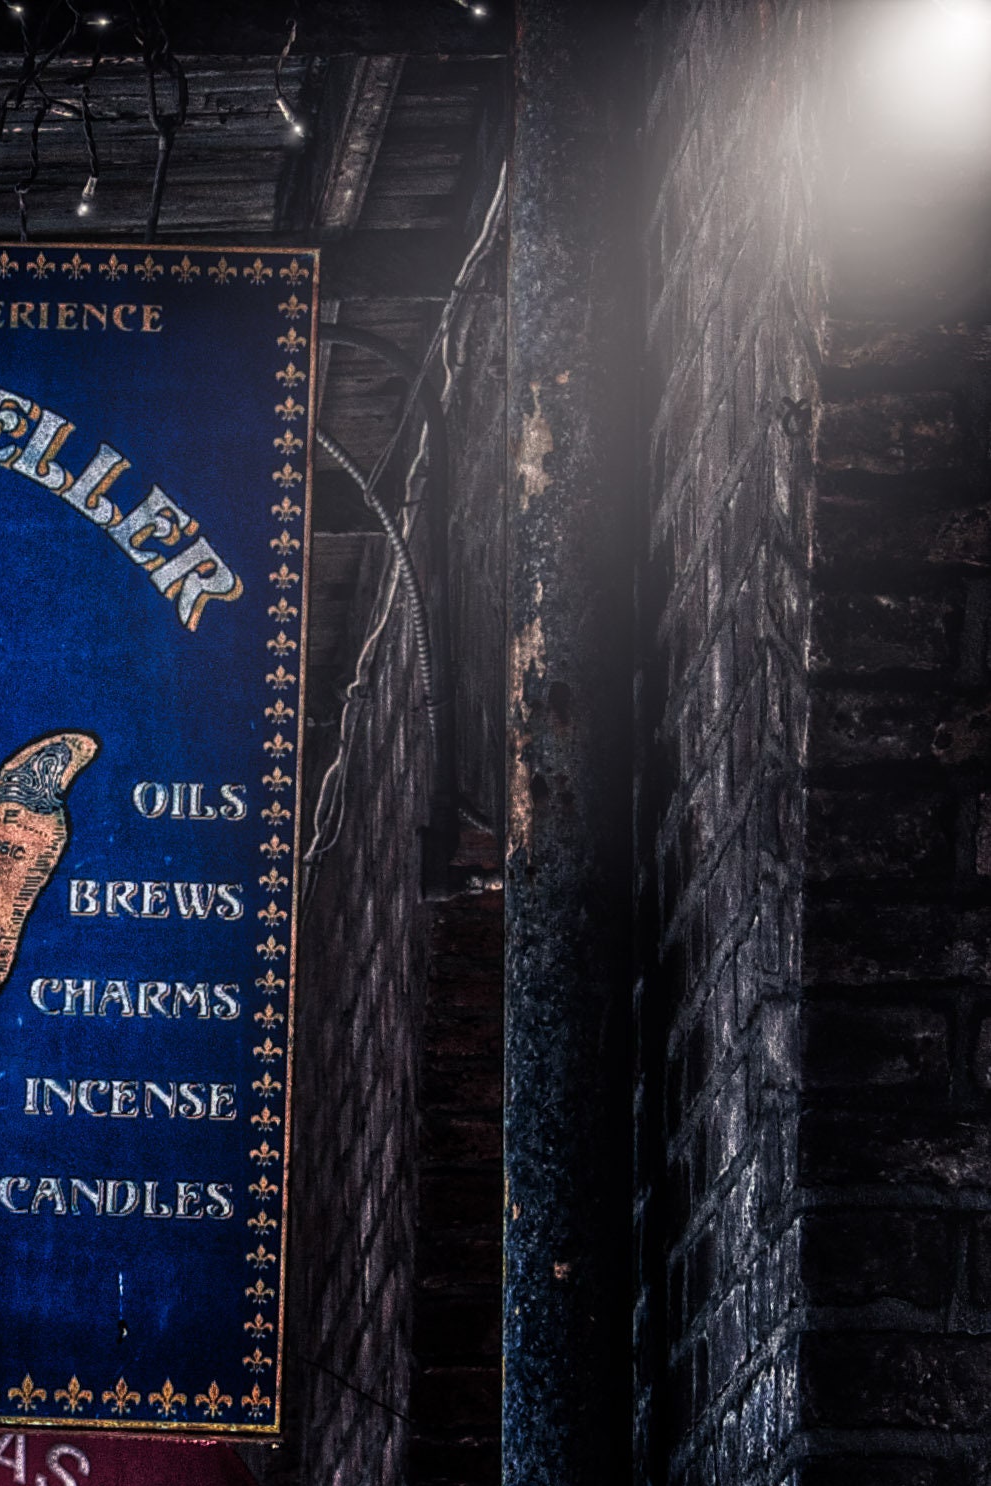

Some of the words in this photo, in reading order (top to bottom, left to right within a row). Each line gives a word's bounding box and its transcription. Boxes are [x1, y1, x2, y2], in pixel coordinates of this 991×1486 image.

[3, 808, 22, 824] E
[132, 780, 248, 821] OILS
[69, 878, 245, 921] BREWS
[30, 977, 242, 1020] CHARMS
[24, 1077, 238, 1121] INCENSE
